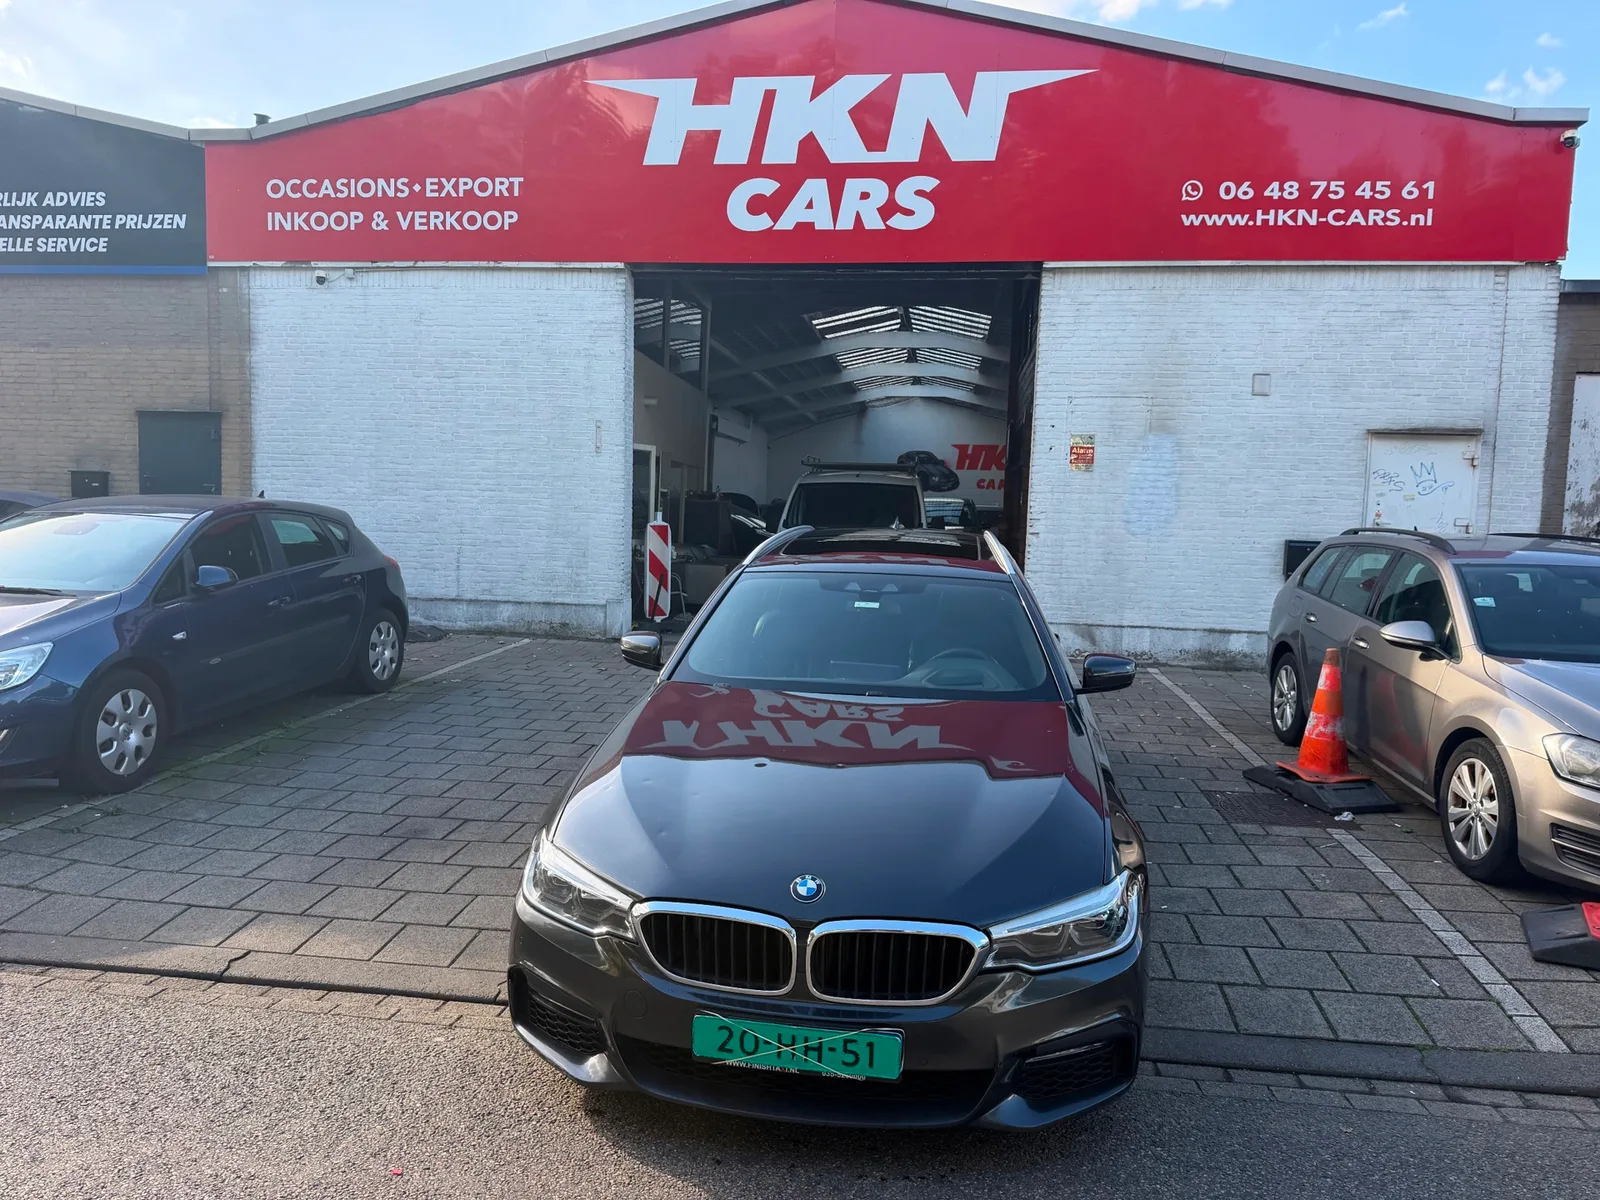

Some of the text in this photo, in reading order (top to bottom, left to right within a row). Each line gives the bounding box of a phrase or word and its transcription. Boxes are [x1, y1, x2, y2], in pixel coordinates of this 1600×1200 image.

[585, 69, 1099, 166] HKN
[266, 177, 524, 199] OCCASIONS EXPORT
[1219, 181, 1435, 200] 06 48 75 45 61
[42, 191, 107, 207] ADVIES
[726, 176, 940, 231] CARS
[115, 213, 187, 229] PRIJZEN
[267, 210, 518, 231] INKOOP & VERKOOP
[1181, 208, 1434, 226] www.HKN-CARS.nl
[0, 237, 108, 252] ELLE SERVICE
[717, 1025, 875, 1069] 20-HH-51
